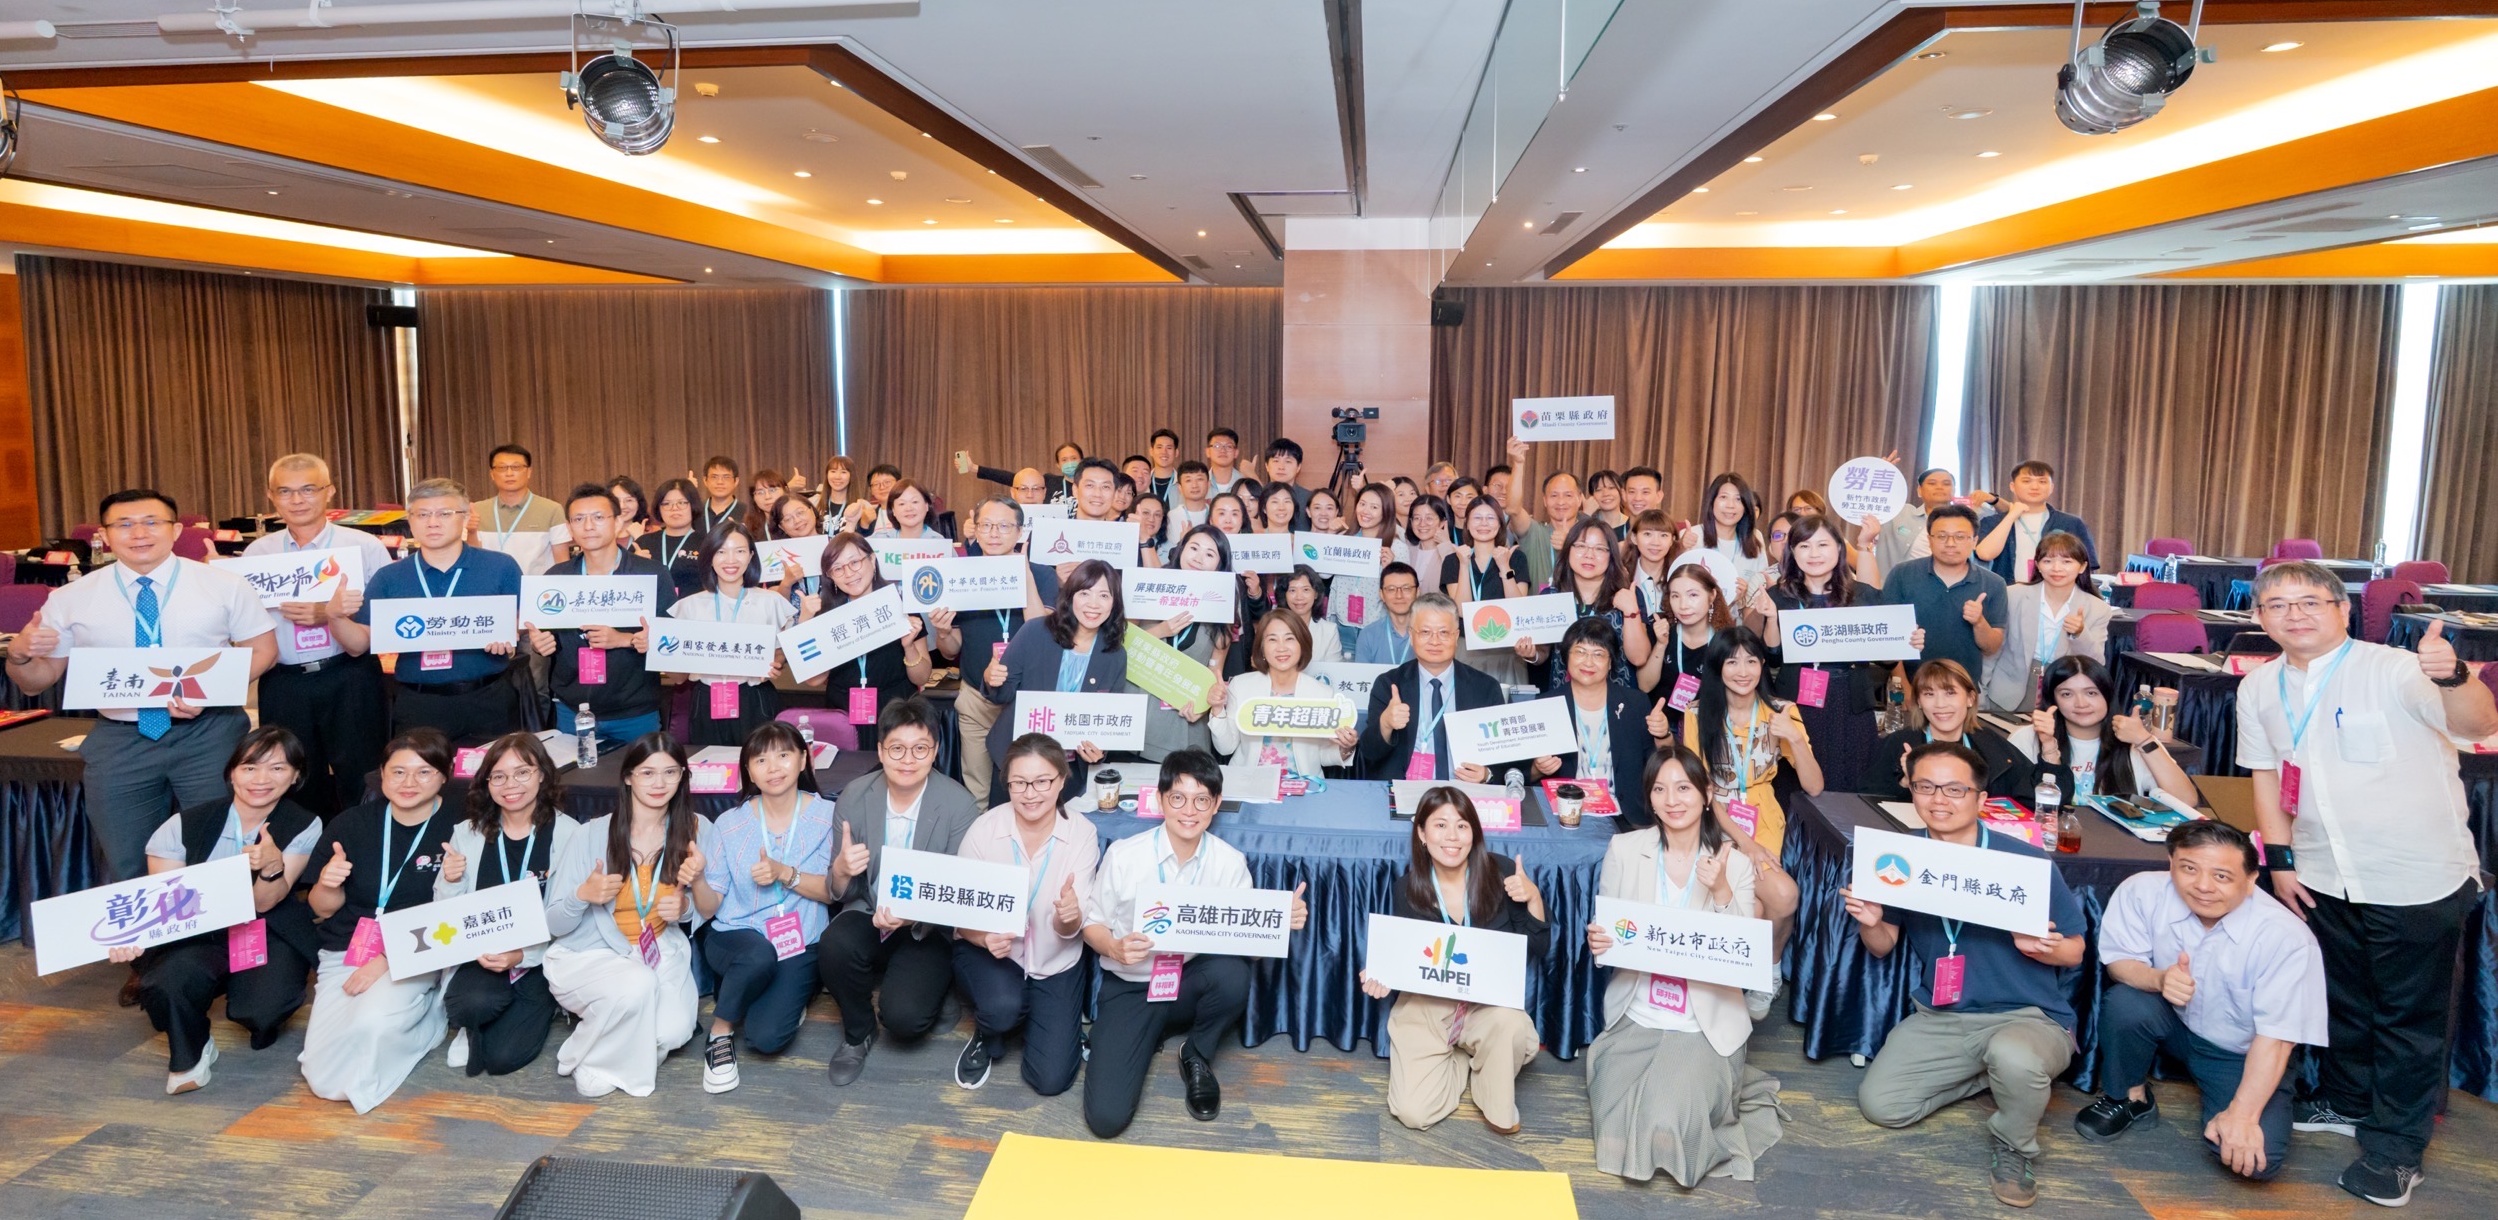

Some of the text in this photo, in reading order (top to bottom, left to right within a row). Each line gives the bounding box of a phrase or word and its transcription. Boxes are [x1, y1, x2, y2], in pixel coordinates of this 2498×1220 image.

[1541, 410, 1608, 421] 苗栗縣政府
[1843, 466, 1896, 493] 勞青
[1846, 494, 1888, 504] 新竹市政府
[1841, 502, 1891, 513] 勞工及青年處
[1077, 540, 1122, 551] 新竹市政府
[1323, 545, 1372, 560] 宜蘭縣政府
[885, 553, 945, 565] KEEUG
[1231, 550, 1281, 560] 花蓮縣政府
[949, 576, 1018, 587] 中華民國外交部
[1134, 582, 1187, 595] 屏東縣政府
[569, 589, 645, 607] 嘉義縣政府
[1159, 596, 1200, 608] 希望城市
[426, 615, 494, 629] 勞動部
[830, 604, 892, 643] 經濟部
[1820, 623, 1888, 637] 澎湖縣政府
[683, 640, 765, 655] 國家發展委員會
[100, 668, 145, 690] 臺南
[1064, 713, 1133, 728] 桃園市政府
[1252, 704, 1341, 728] 青年超讚!
[1501, 714, 1527, 726] 教育部
[1503, 722, 1546, 737] 青年發展署
[1918, 868, 2028, 905] 金門縣政府
[918, 882, 1015, 913] 南投縣政府
[462, 906, 513, 929] 嘉義市
[1177, 903, 1283, 929] 高雄市政府
[149, 920, 198, 940] 縣政府
[466, 922, 514, 940] CHIAYI CITY
[1175, 928, 1217, 936] KAOHSIUNG
[1233, 932, 1281, 940] GOVERNMENT
[1644, 925, 1750, 958] 新北市政府
[1647, 945, 1753, 967] New Taipei City Government
[1419, 966, 1471, 986] TAIPEI
